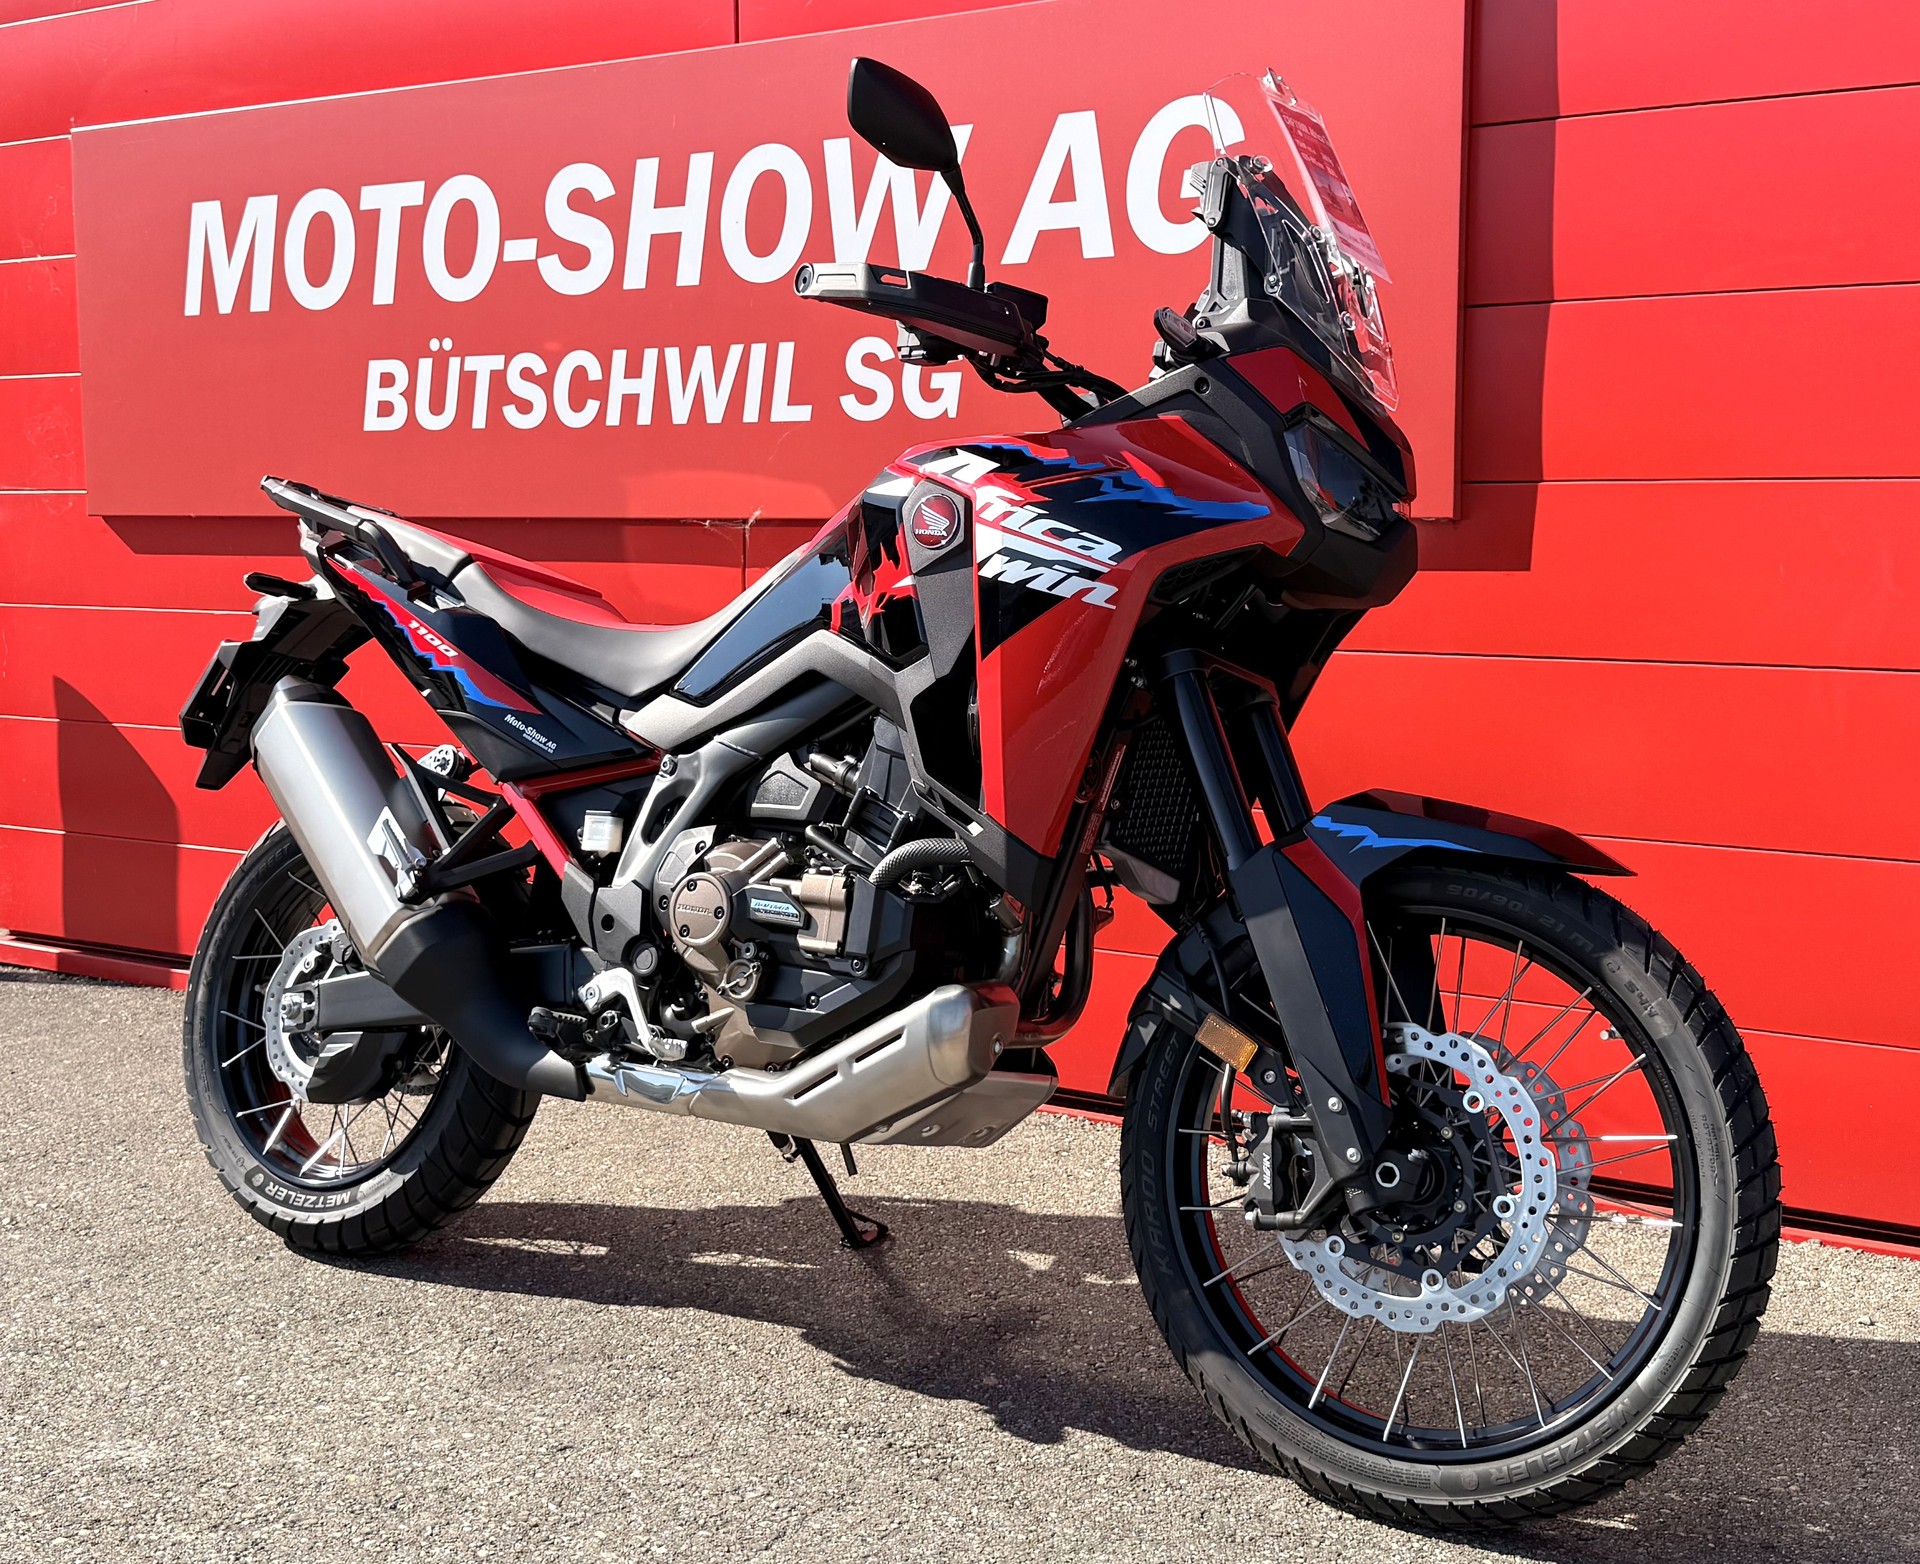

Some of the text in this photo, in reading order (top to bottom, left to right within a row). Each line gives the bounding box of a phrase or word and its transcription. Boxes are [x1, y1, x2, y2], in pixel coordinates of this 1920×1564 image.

[184, 94, 1246, 316] MOTO-SHOW AG
[363, 336, 963, 432] BÜTSCHWIL SG
[914, 528, 948, 537] HONDA
[408, 619, 459, 657] 1100
[504, 713, 548, 744] Moto-Show
[545, 740, 557, 750] AG
[1141, 1031, 1180, 1276] KAROO STREET
[264, 1181, 351, 1208] METZELER
[1489, 1398, 1640, 1486] METZELER
